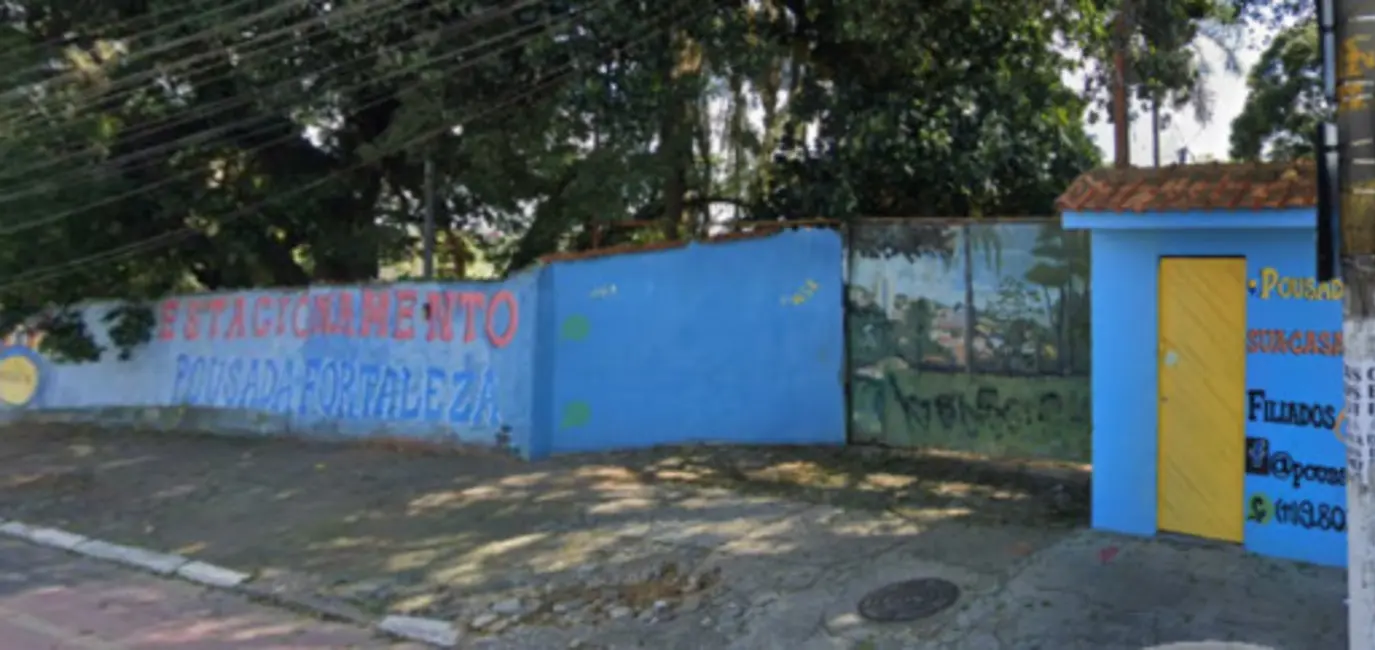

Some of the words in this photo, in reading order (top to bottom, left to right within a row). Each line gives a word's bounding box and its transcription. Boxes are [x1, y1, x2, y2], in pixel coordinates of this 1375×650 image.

[1260, 267, 1345, 301] POUSAD
[158, 288, 518, 348] ESTACIONAMENTO
[172, 352, 295, 411] POUSADA
[298, 356, 500, 426] FORTALEZA
